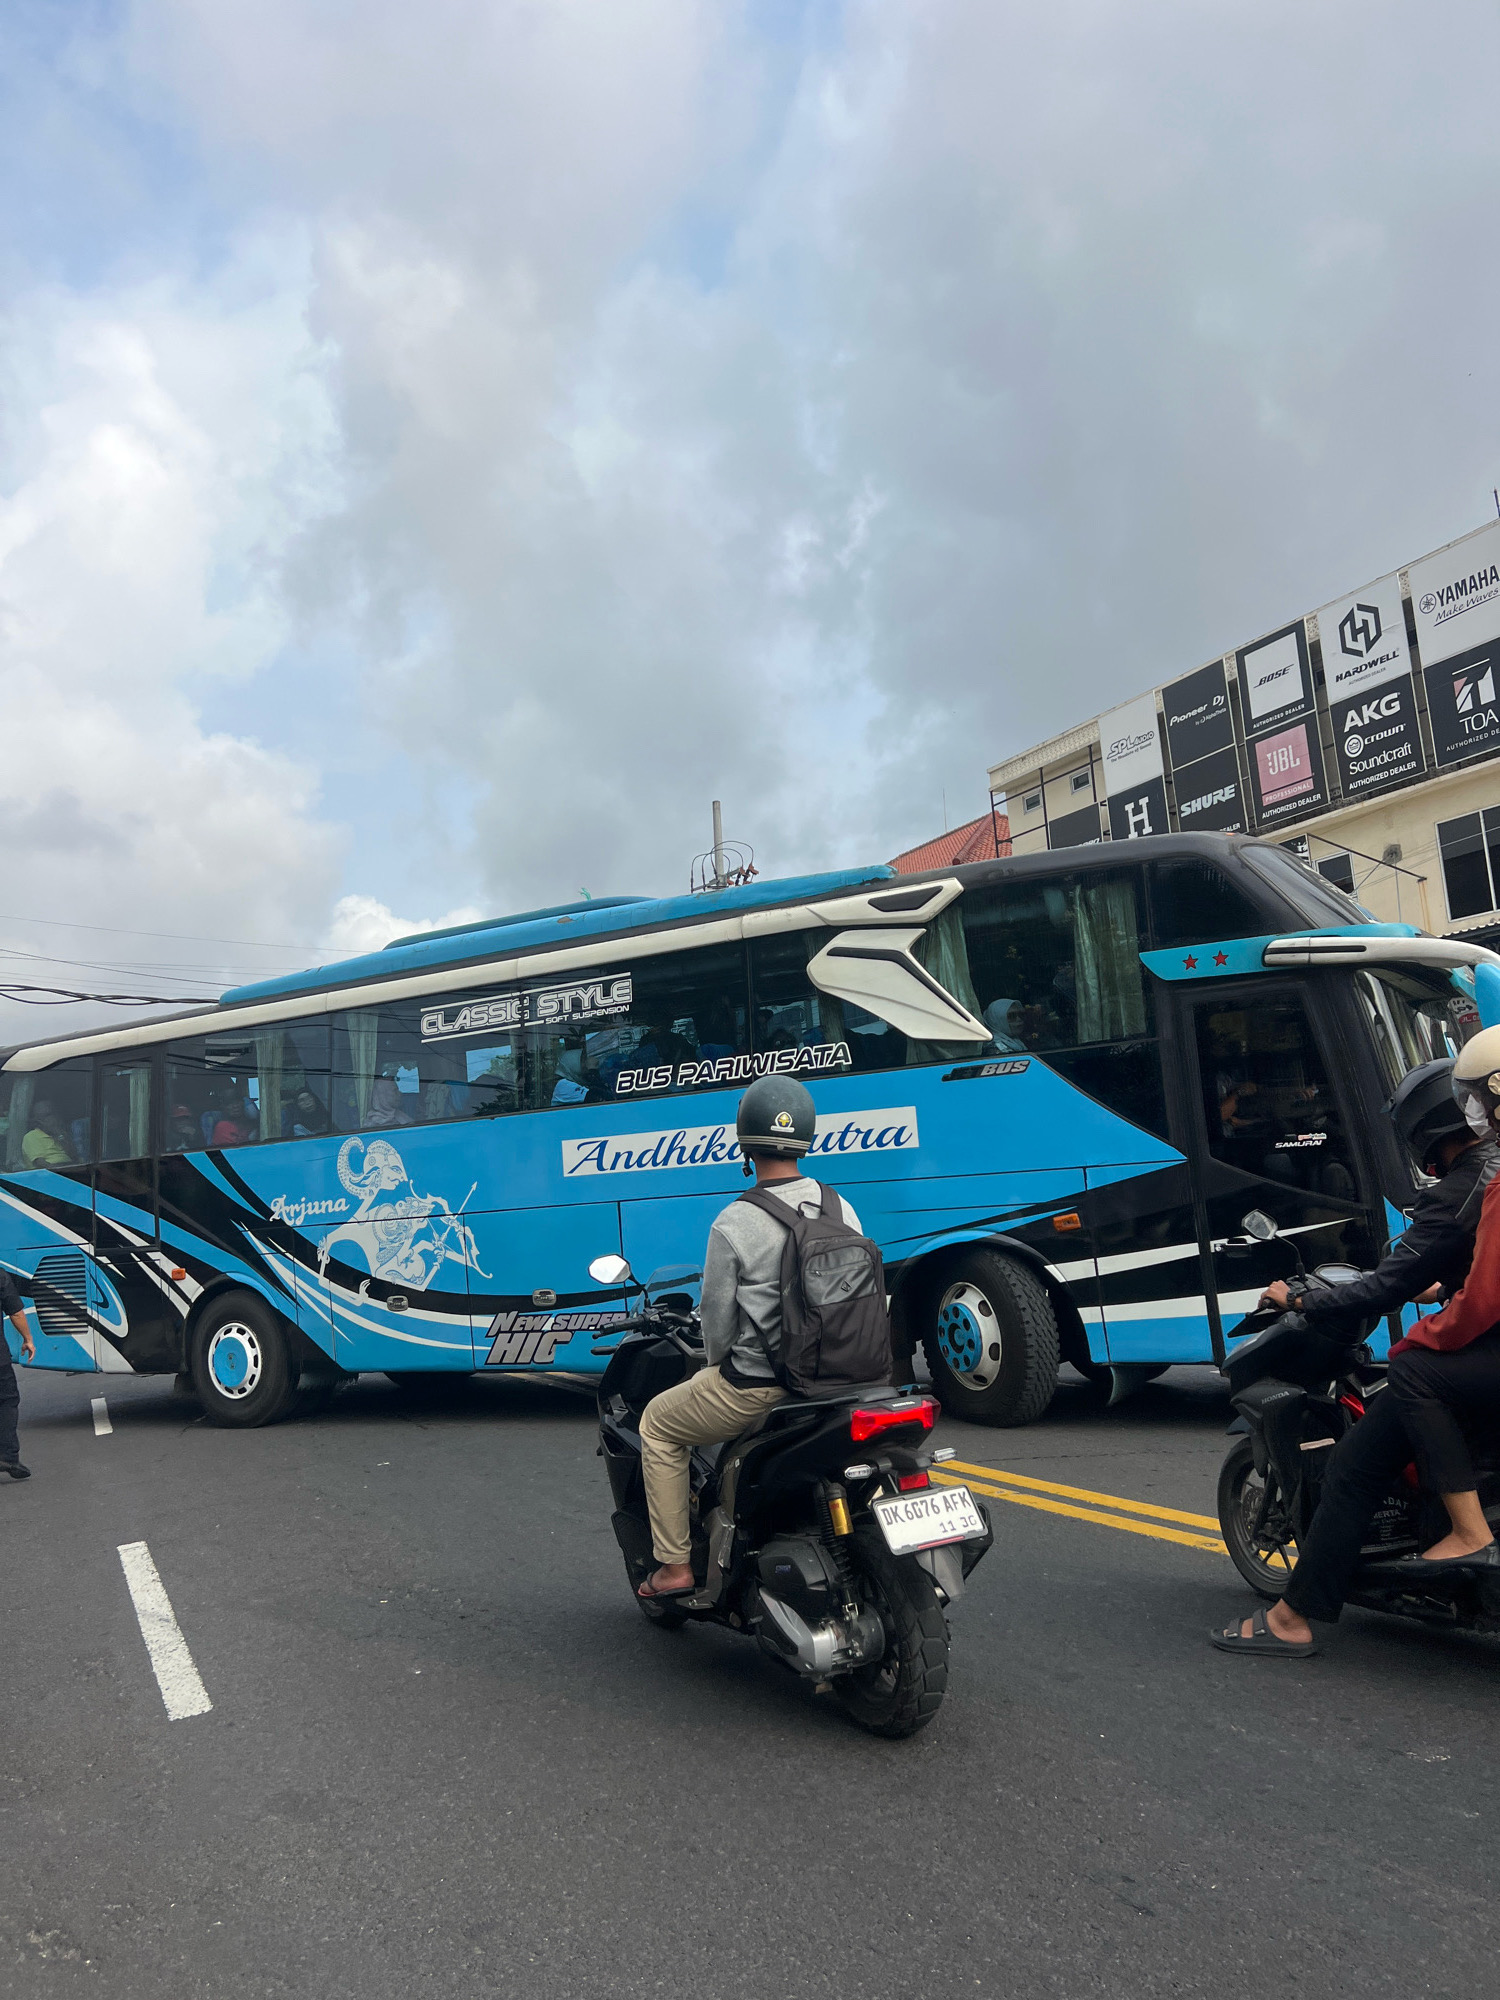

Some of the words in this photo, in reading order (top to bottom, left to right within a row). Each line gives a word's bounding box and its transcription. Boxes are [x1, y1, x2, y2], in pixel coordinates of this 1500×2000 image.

[1436, 565, 1500, 607] YAMAHA
[1436, 604, 1464, 622] Make
[1466, 588, 1499, 607] Waves
[1253, 663, 1294, 689] BOSE
[1335, 650, 1399, 683] HARDWELL
[1170, 703, 1208, 727] Pioneer
[1252, 713, 1284, 729] AUTHORIZED
[1285, 703, 1305, 716] DEALER
[1343, 692, 1401, 733] AKG
[1459, 708, 1500, 734] TOA
[1364, 724, 1405, 745] crown
[1446, 733, 1489, 752] AUTHORIZED
[1491, 728, 1500, 736] DE
[1266, 744, 1301, 776] JBL
[1349, 742, 1412, 775] Soundcraft
[1349, 771, 1389, 790] AUTHORIZED
[1389, 761, 1417, 776] DEALER
[1180, 783, 1237, 818] SHURE
[1262, 803, 1298, 819] AUTHORIZED
[1297, 793, 1322, 808] DEALER
[1265, 782, 1311, 803] PROFESSIONAL
[420, 995, 530, 1036] CLASSIC
[537, 978, 633, 1018] STYLE
[545, 1014, 570, 1025] SOFT
[572, 1004, 630, 1021] SUSPENSION
[616, 1065, 673, 1094] BUS
[677, 1041, 852, 1086] PARIWISATA
[806, 1121, 912, 1154] utra
[1275, 1140, 1322, 1149] SAMURAI
[269, 1194, 350, 1226] Arjuna
[1262, 1391, 1289, 1404] HONDA
[881, 1505, 906, 1526] DK
[942, 1491, 972, 1513] AFK
[939, 1521, 957, 1534] 11
